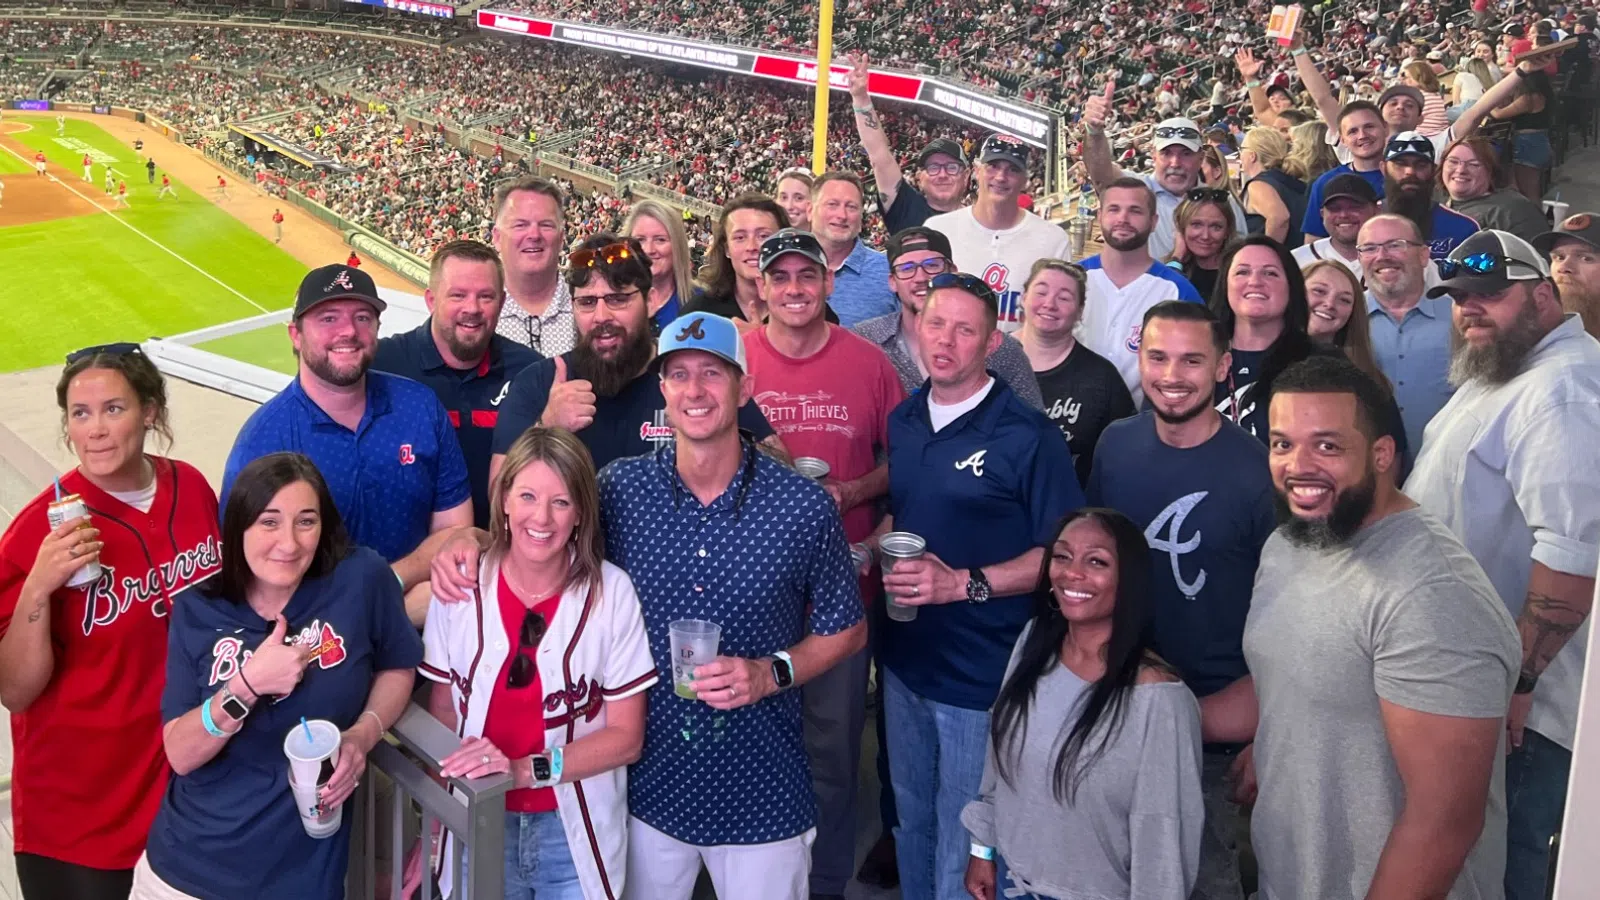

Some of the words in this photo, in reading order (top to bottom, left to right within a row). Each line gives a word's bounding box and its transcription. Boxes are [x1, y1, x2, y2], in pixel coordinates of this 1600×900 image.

[648, 41, 658, 52] OF
[658, 43, 672, 55] THE
[671, 45, 706, 60] ATLANTA
[705, 50, 738, 67] BRAVES
[1032, 121, 1048, 139] OF
[798, 400, 849, 421] THIEVES
[82, 535, 219, 636] Braves
[680, 648, 694, 659] LP
